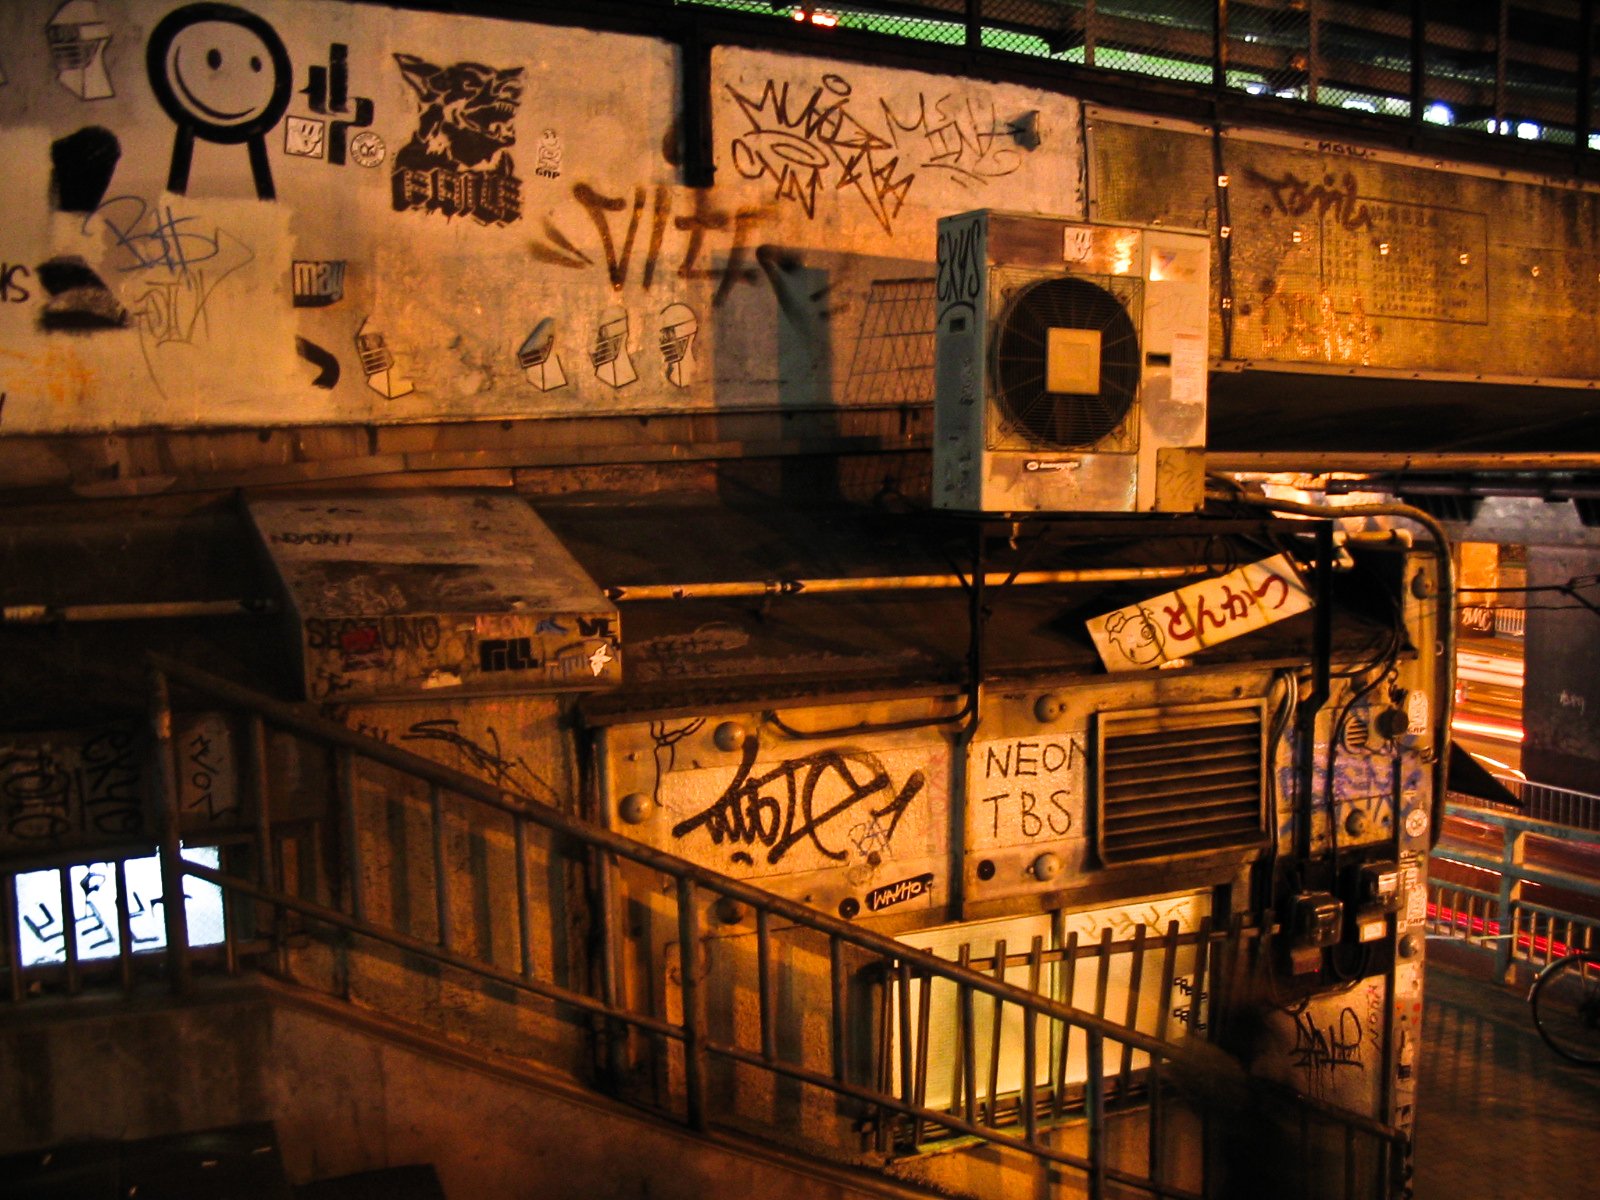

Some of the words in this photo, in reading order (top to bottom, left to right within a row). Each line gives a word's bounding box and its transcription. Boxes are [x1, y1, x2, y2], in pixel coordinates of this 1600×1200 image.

[1163, 574, 1289, 641] とんかつ
[985, 737, 1089, 778] NEON
[982, 789, 1072, 838] TBS
